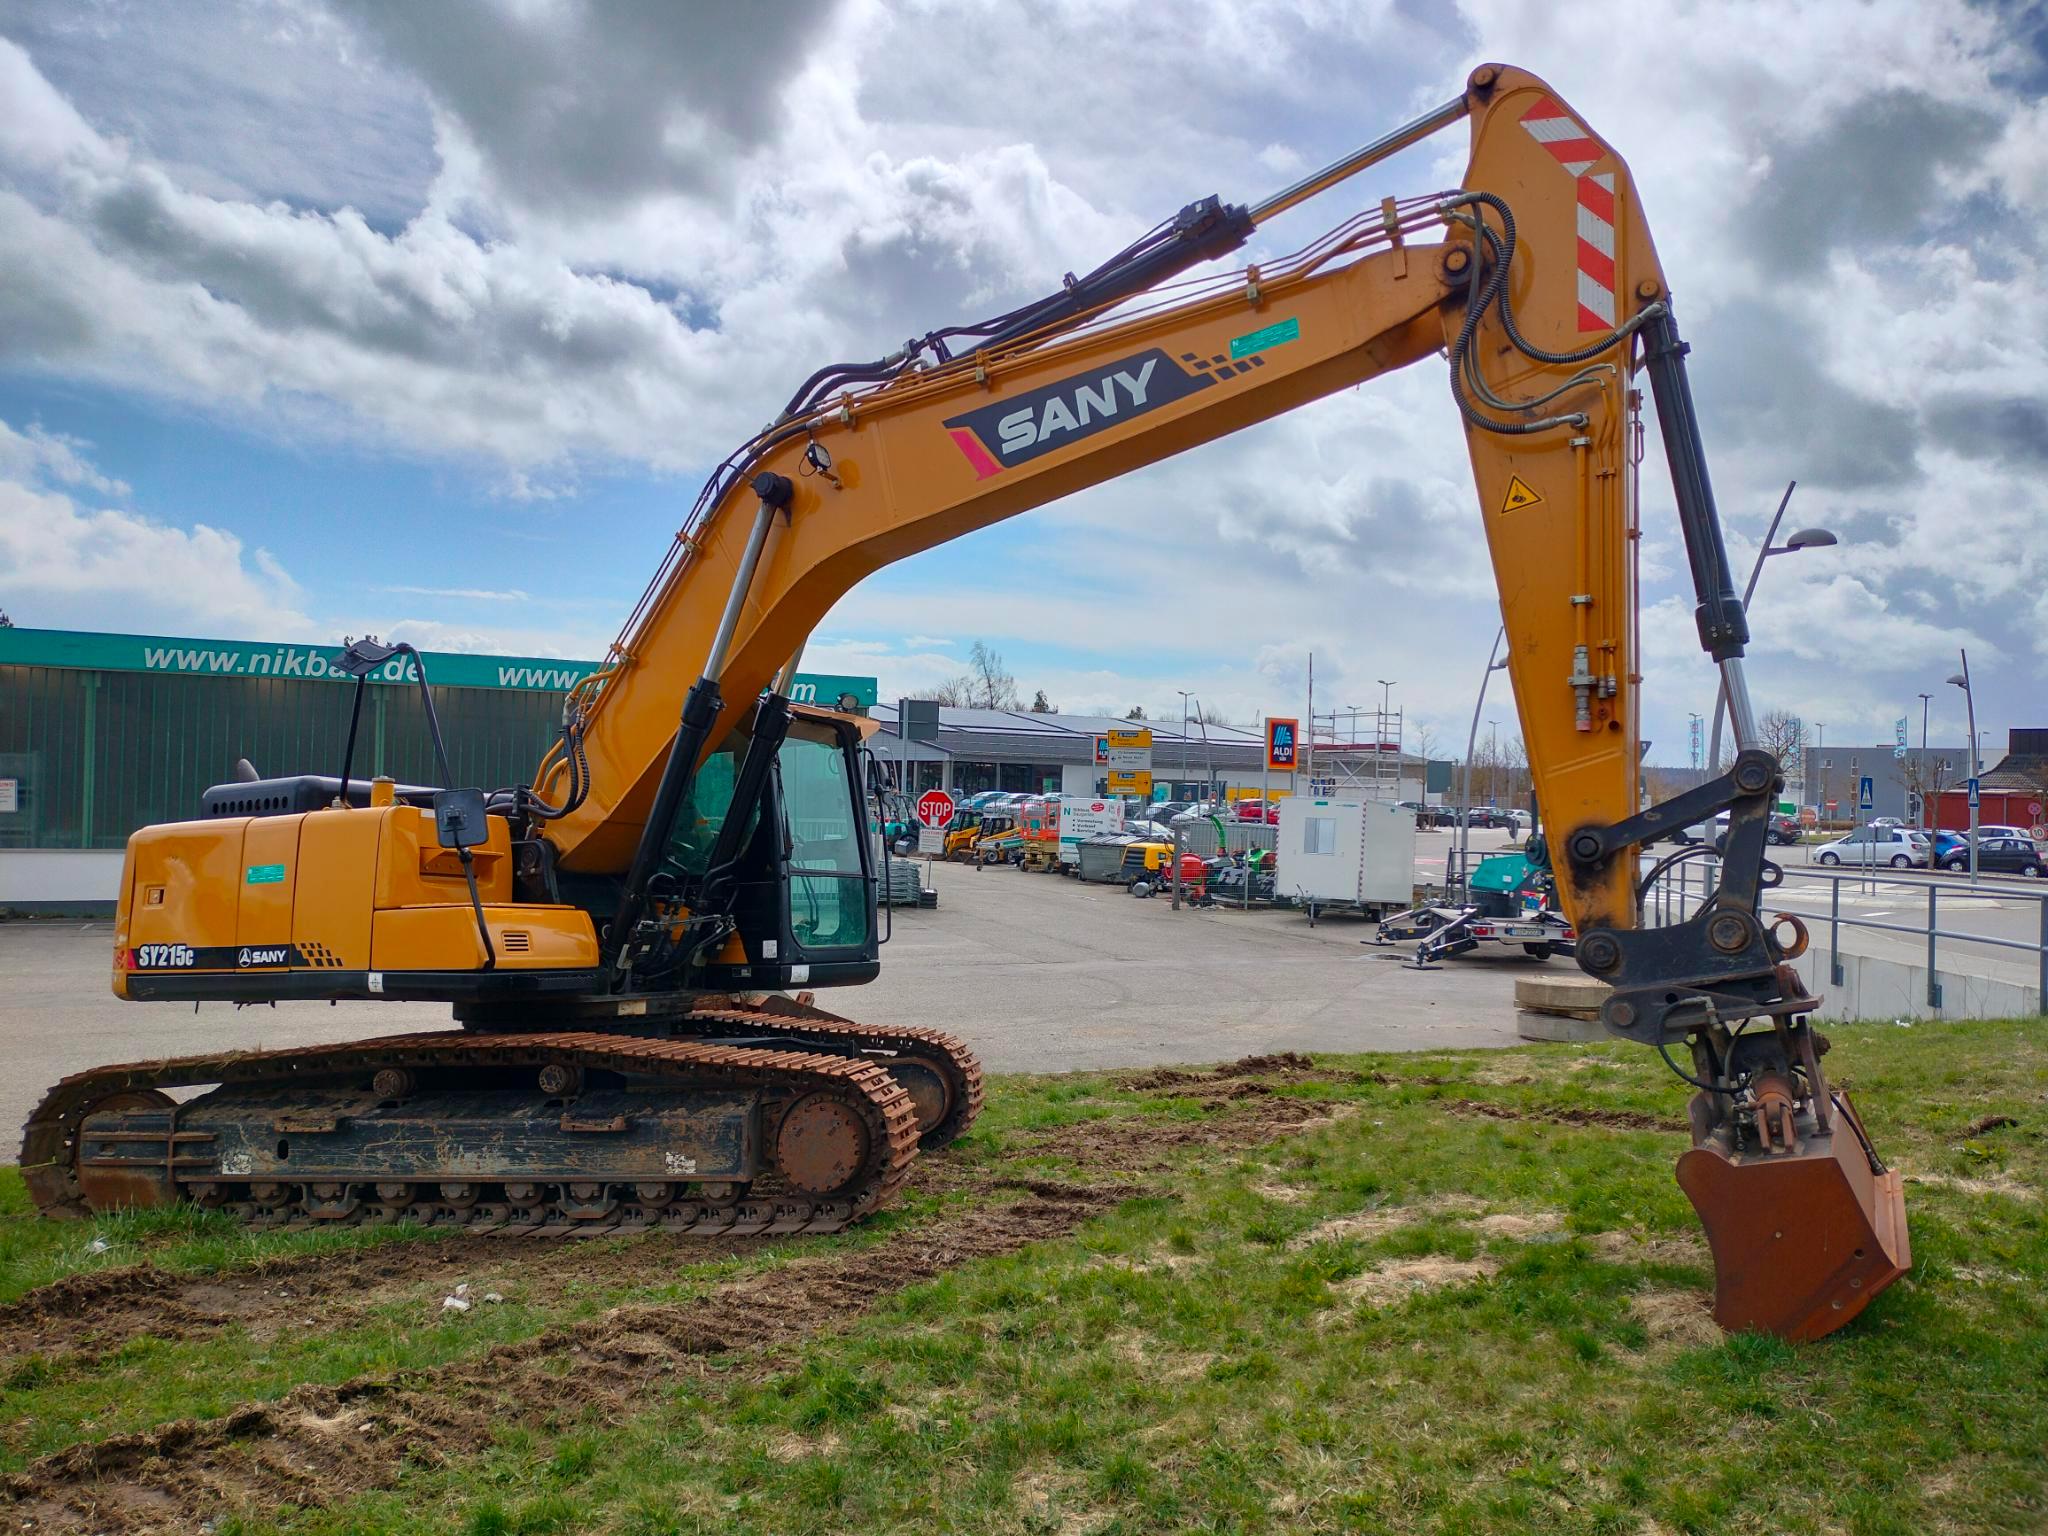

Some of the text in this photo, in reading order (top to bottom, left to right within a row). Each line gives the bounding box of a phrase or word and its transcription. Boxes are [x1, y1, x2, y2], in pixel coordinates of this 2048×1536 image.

[998, 358, 1157, 455] SANY
[145, 647, 425, 682] www.nikba.de
[1273, 746, 1292, 756] ALDI
[920, 801, 951, 817] STOP
[1063, 807, 1071, 816] N
[2033, 828, 2043, 837] 10
[252, 950, 286, 964] SANY
